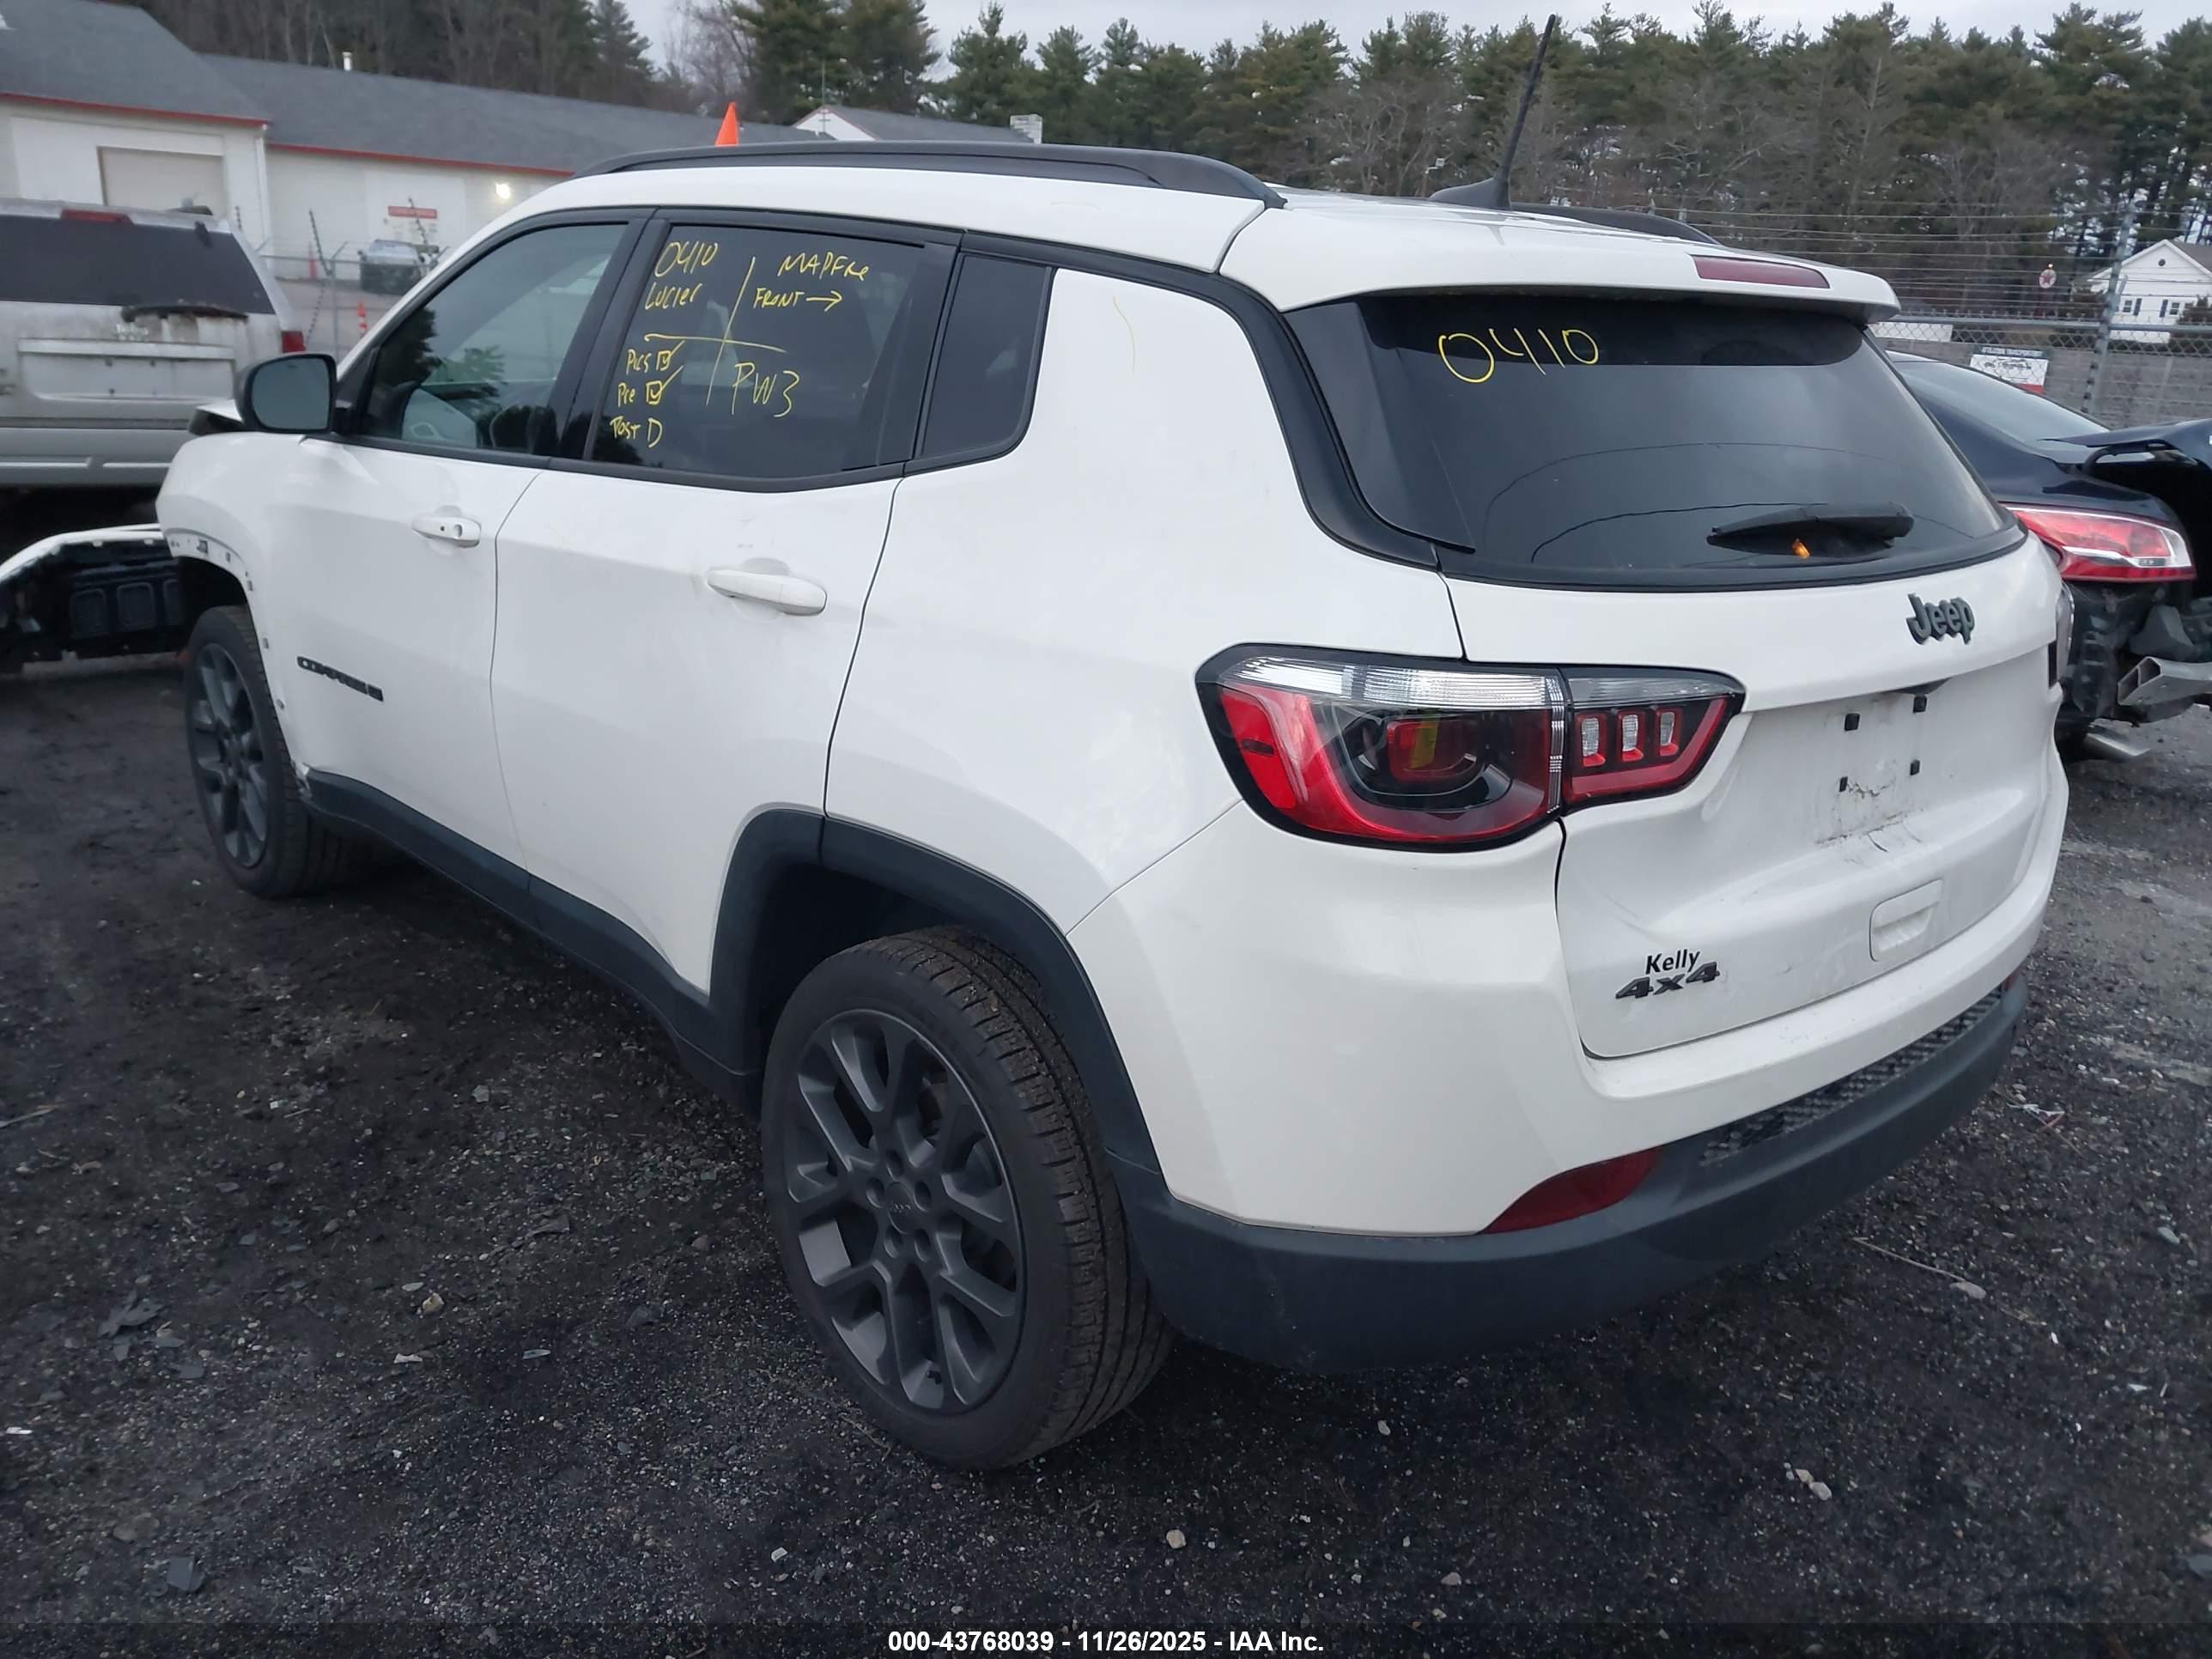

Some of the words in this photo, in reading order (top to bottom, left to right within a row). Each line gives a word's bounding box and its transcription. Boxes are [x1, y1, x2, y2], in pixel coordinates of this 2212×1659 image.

[654, 240, 719, 277] 0410
[753, 287, 805, 308] FRONT
[1437, 327, 1600, 384] 0410
[731, 362, 800, 418] PW3
[1905, 592, 1975, 646] Jeep
[1645, 948, 1700, 975] Kelly
